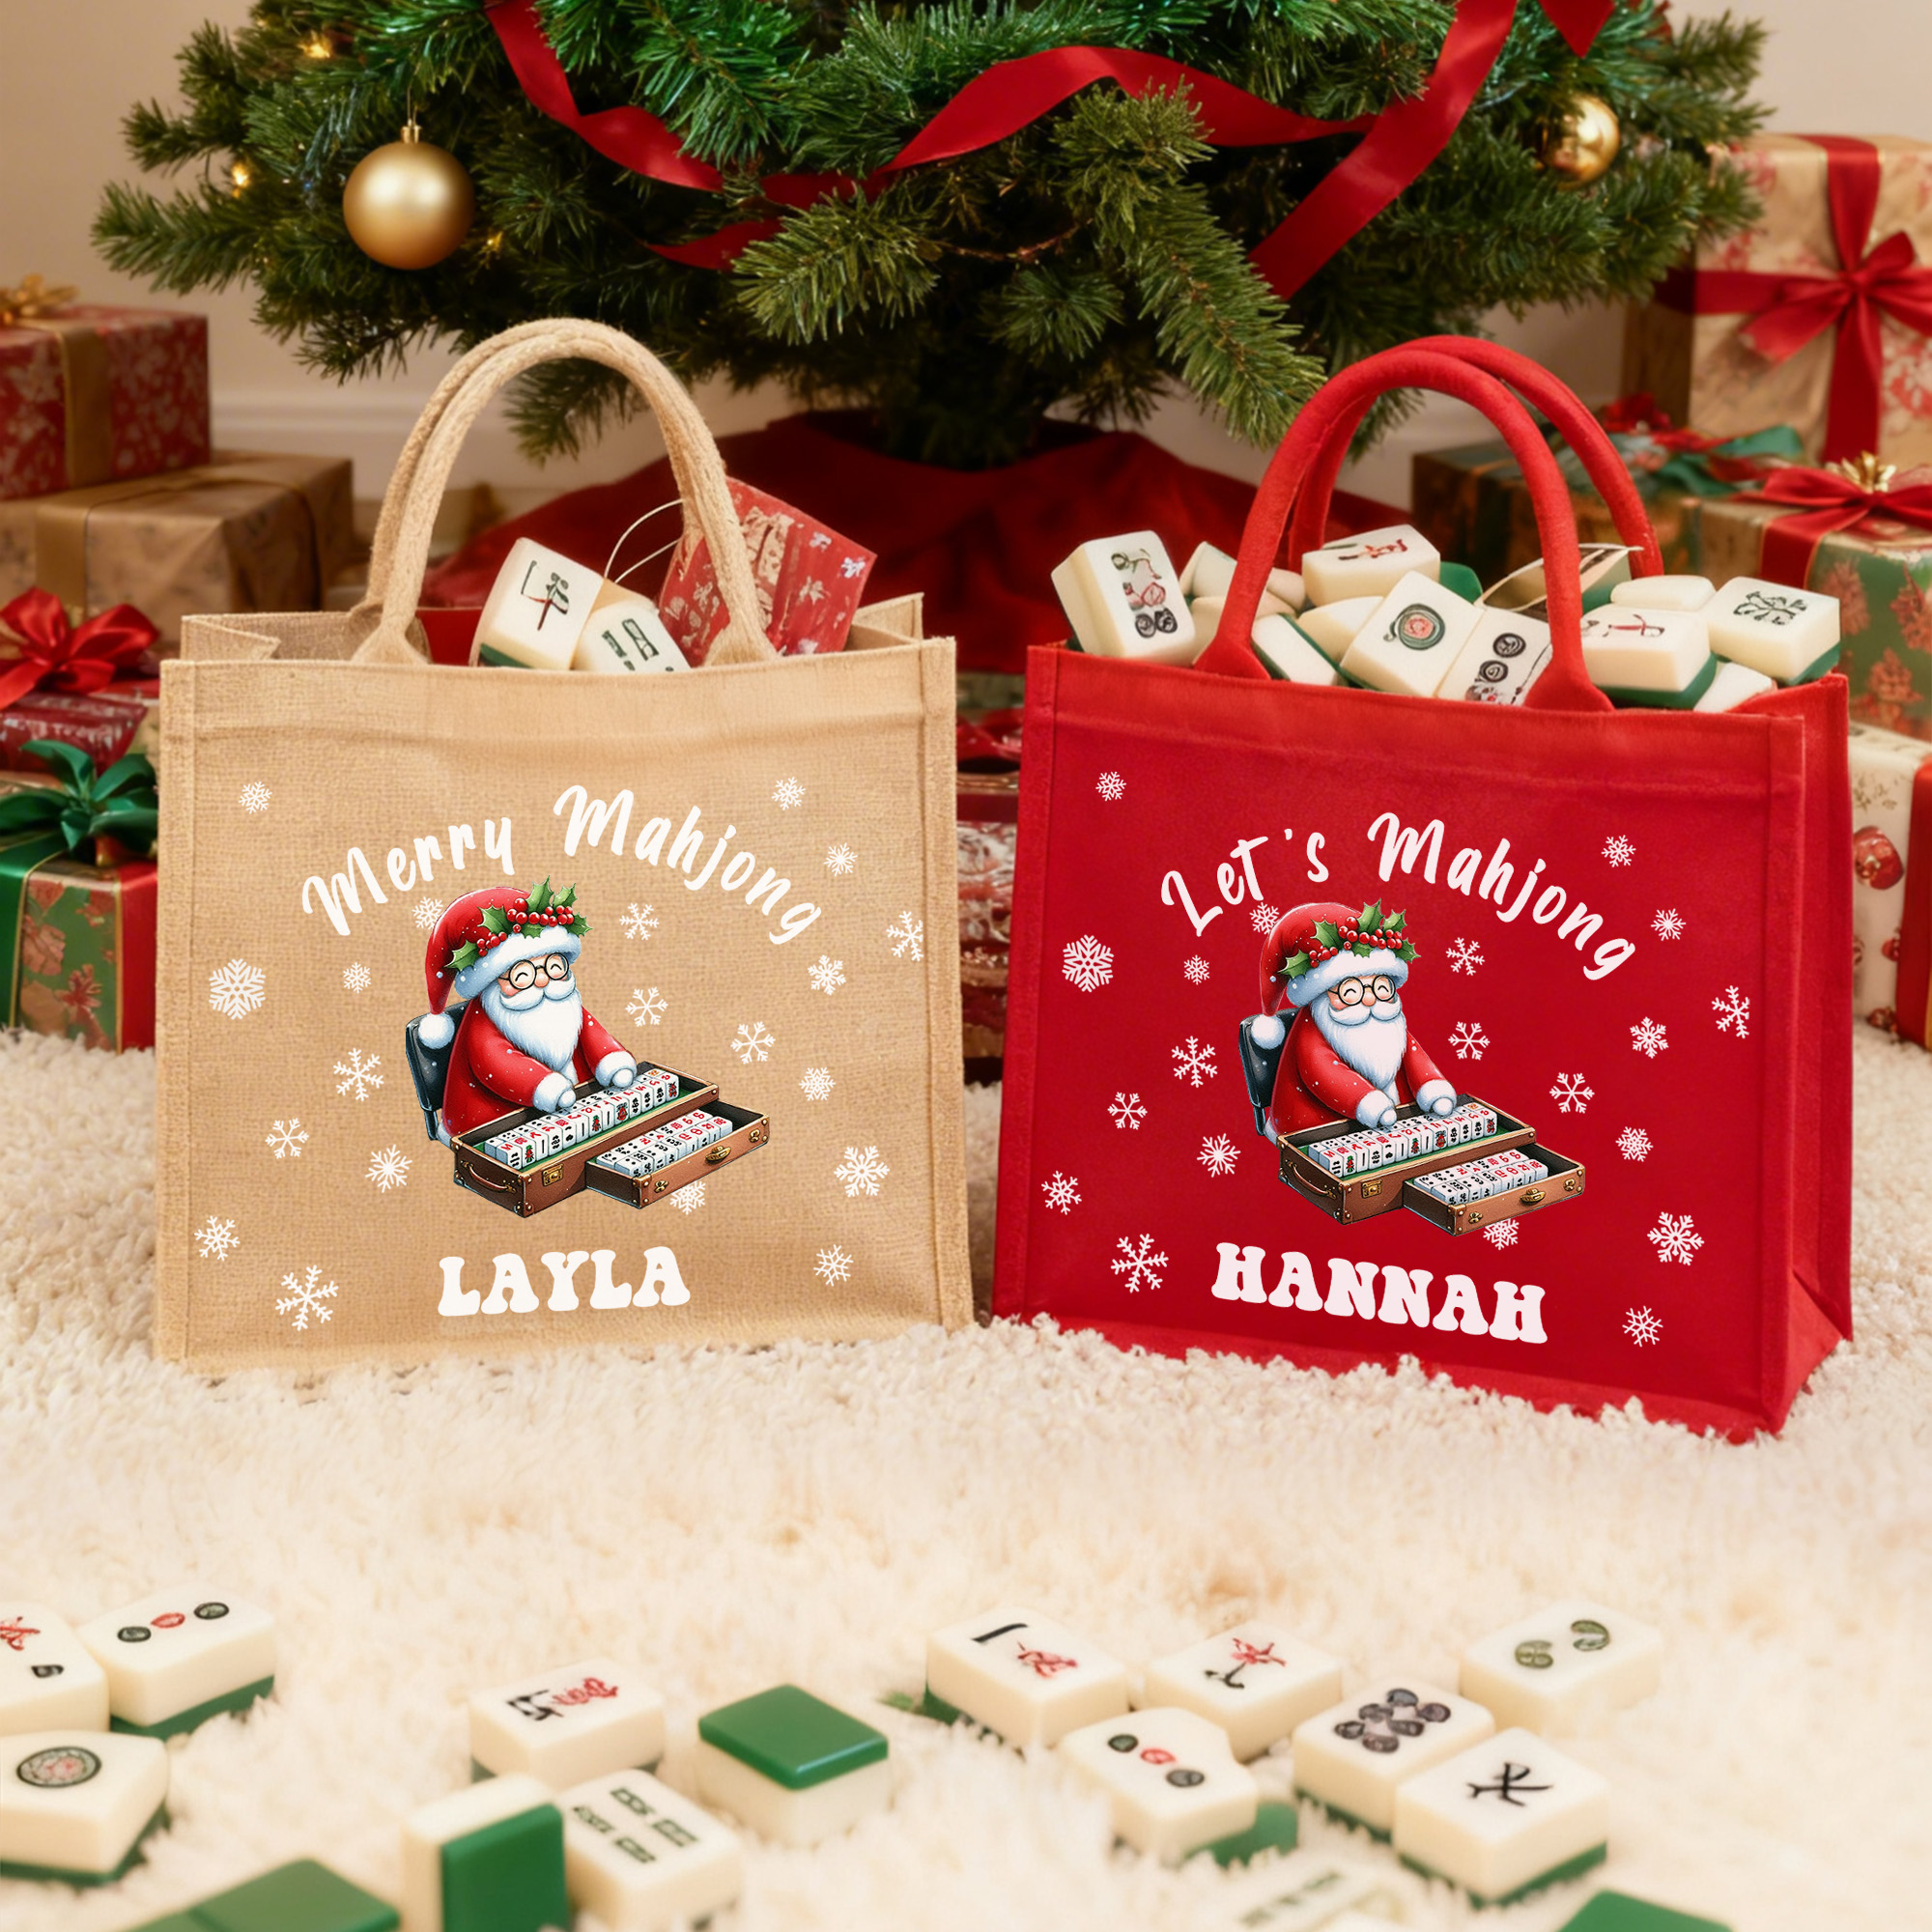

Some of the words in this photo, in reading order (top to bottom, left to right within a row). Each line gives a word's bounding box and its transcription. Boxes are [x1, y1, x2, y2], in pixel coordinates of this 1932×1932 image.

[301, 816, 515, 936] Merry
[553, 784, 822, 945] Mahjong
[1367, 812, 1635, 980] Mahjong
[438, 1246, 691, 1317] LAYLA
[1211, 1242, 1548, 1344] HANNAH
